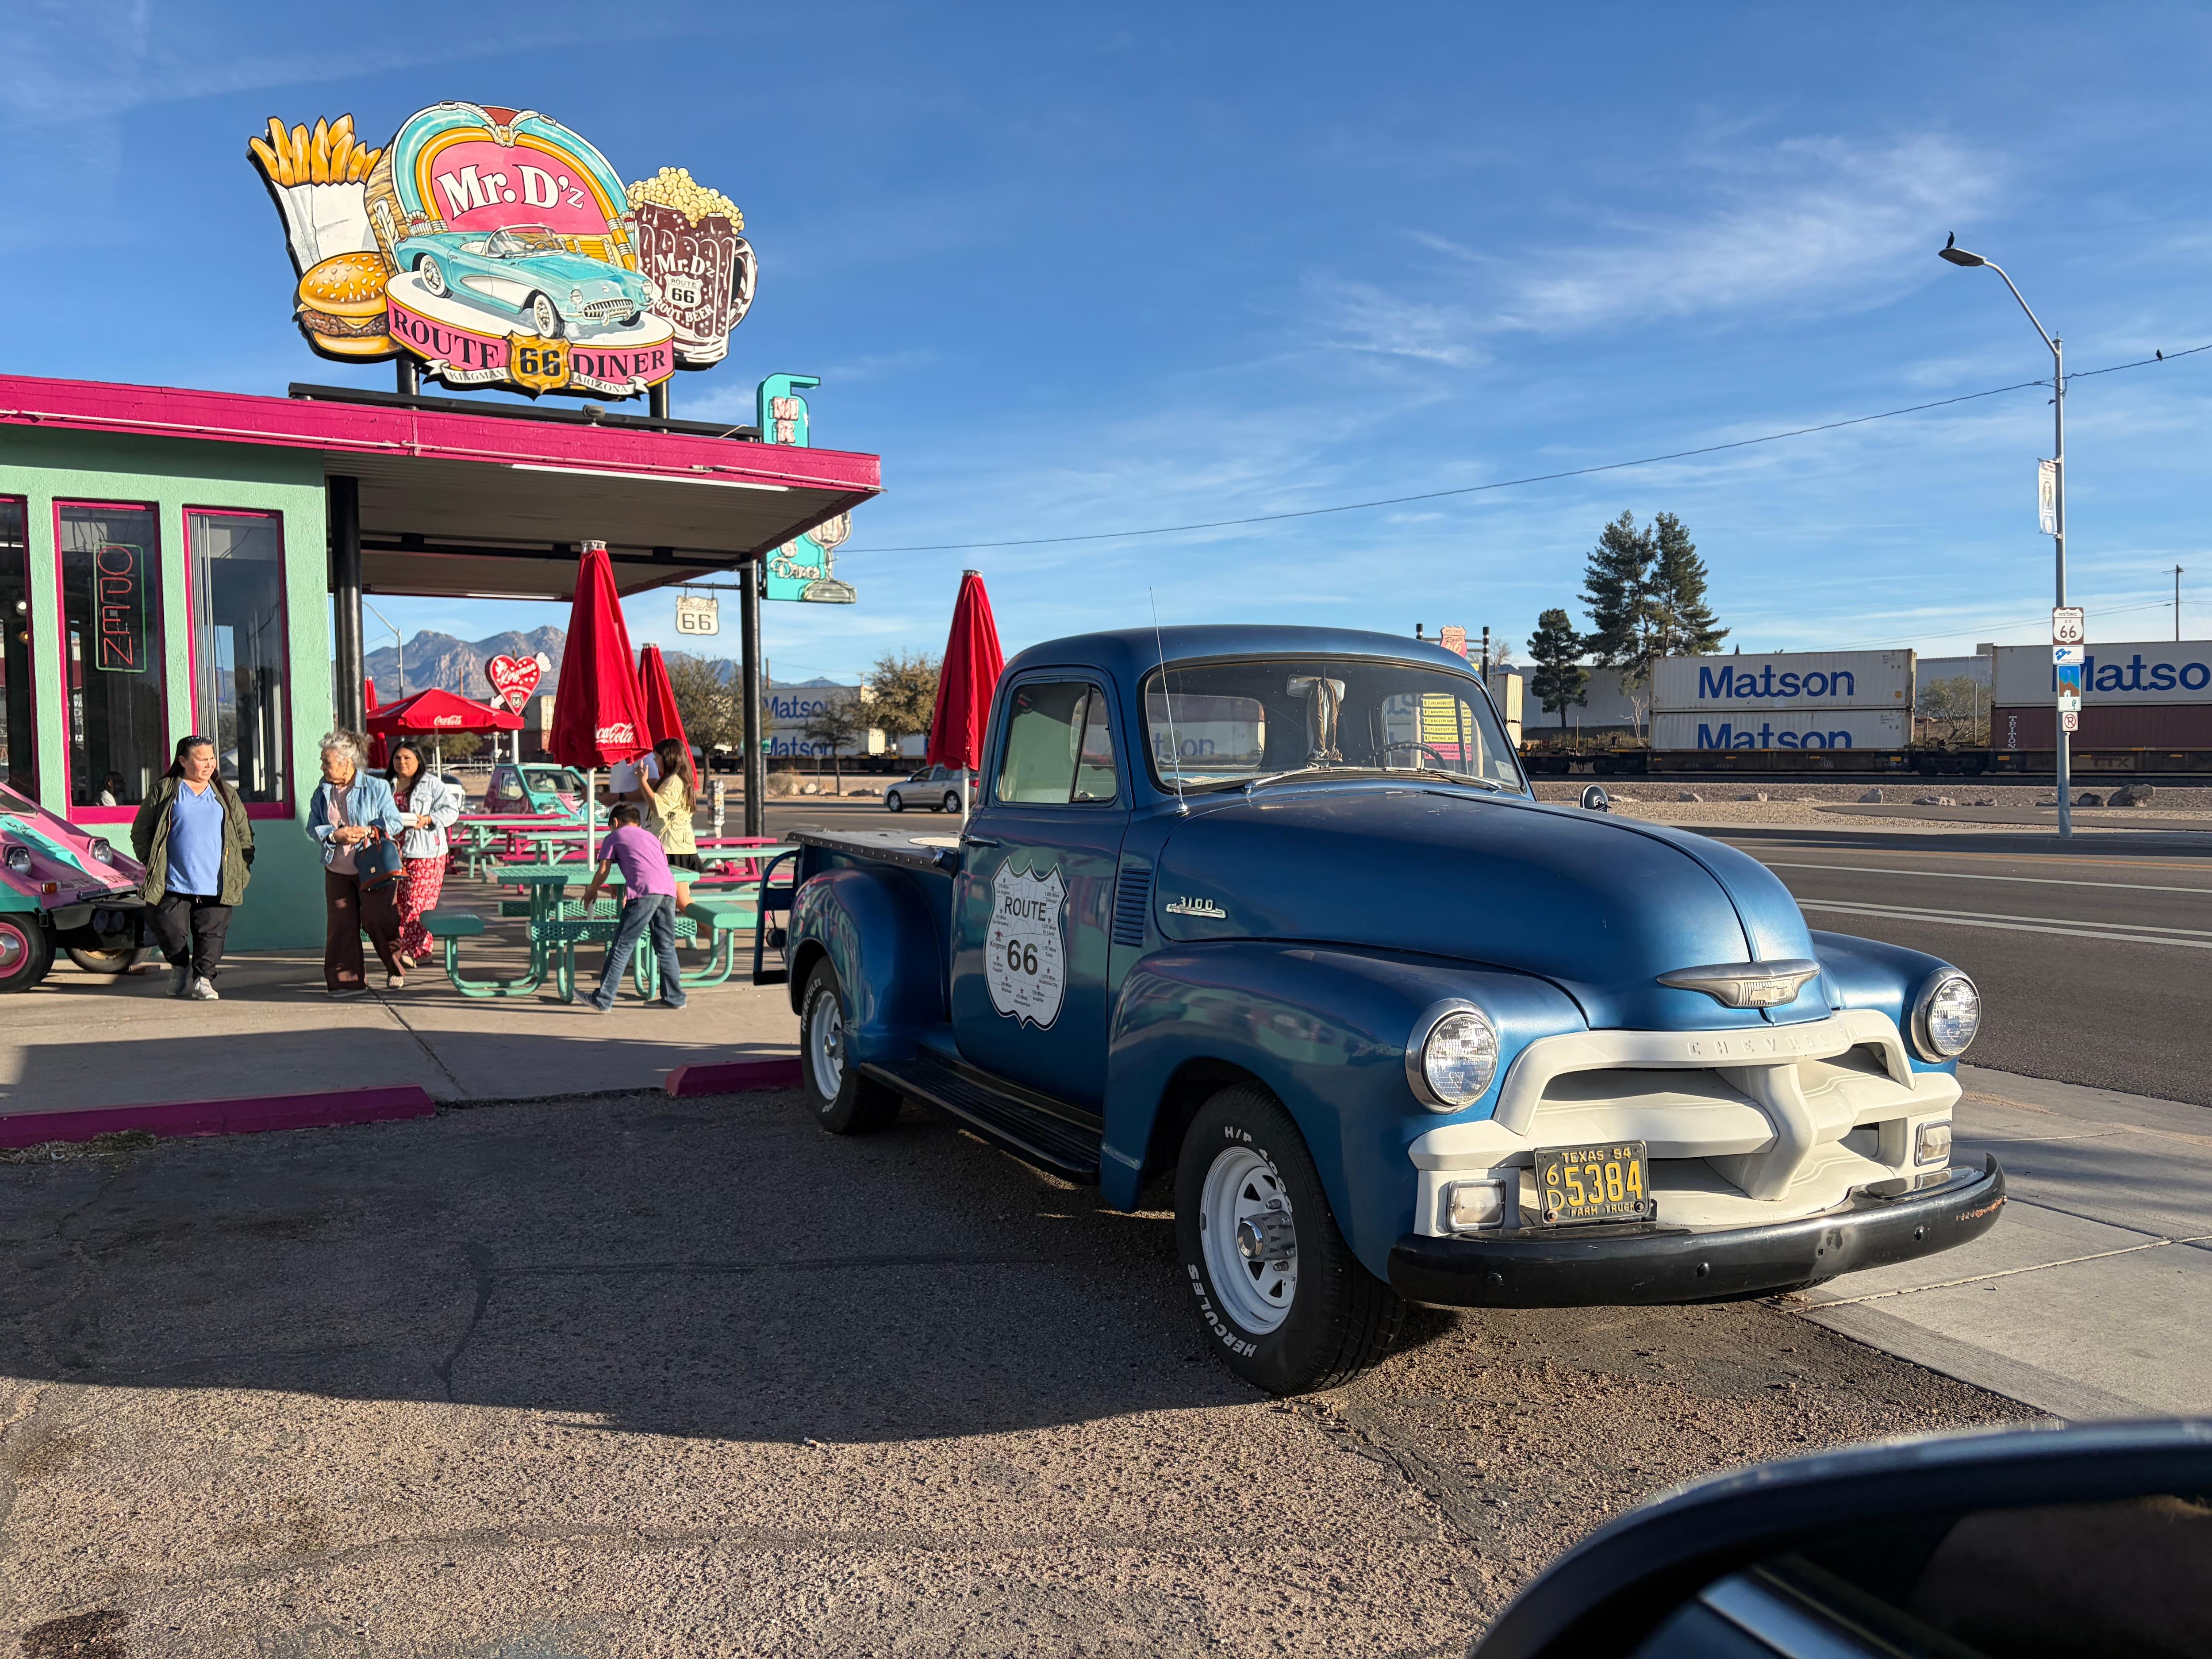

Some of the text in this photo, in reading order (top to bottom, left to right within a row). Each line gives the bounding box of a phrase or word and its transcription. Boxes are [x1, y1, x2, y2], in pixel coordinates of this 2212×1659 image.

[434, 164, 585, 221] Mr. D'z
[655, 253, 689, 274] Mr.
[671, 278, 697, 288] ROUTE
[672, 288, 695, 303] 66
[656, 298, 714, 323] ROOT BEER
[392, 306, 666, 377] ROUTE 66 DINER
[449, 369, 628, 393] KINGMAN ARIZONA
[97, 545, 133, 666] OPEN
[682, 613, 711, 630] 66
[2060, 625, 2077, 638] 66
[1699, 665, 1854, 699] Matson
[1697, 723, 1852, 749] Matson
[2008, 715, 2017, 749] TRITON
[2090, 757, 2130, 768] TTX
[1004, 895, 1047, 922] ROUTE
[1180, 896, 1214, 910] 3100
[1007, 939, 1038, 975] 66
[801, 978, 822, 1032] HERCULES
[1561, 1147, 1632, 1164] TEXAS 54
[1224, 1126, 1293, 1213] H/P 4000
[1546, 1163, 1559, 1187] 6
[1563, 1160, 1643, 1207] 5384
[1571, 1203, 1636, 1217] FARM TRUCK
[1187, 1263, 1258, 1358] HERCULES
